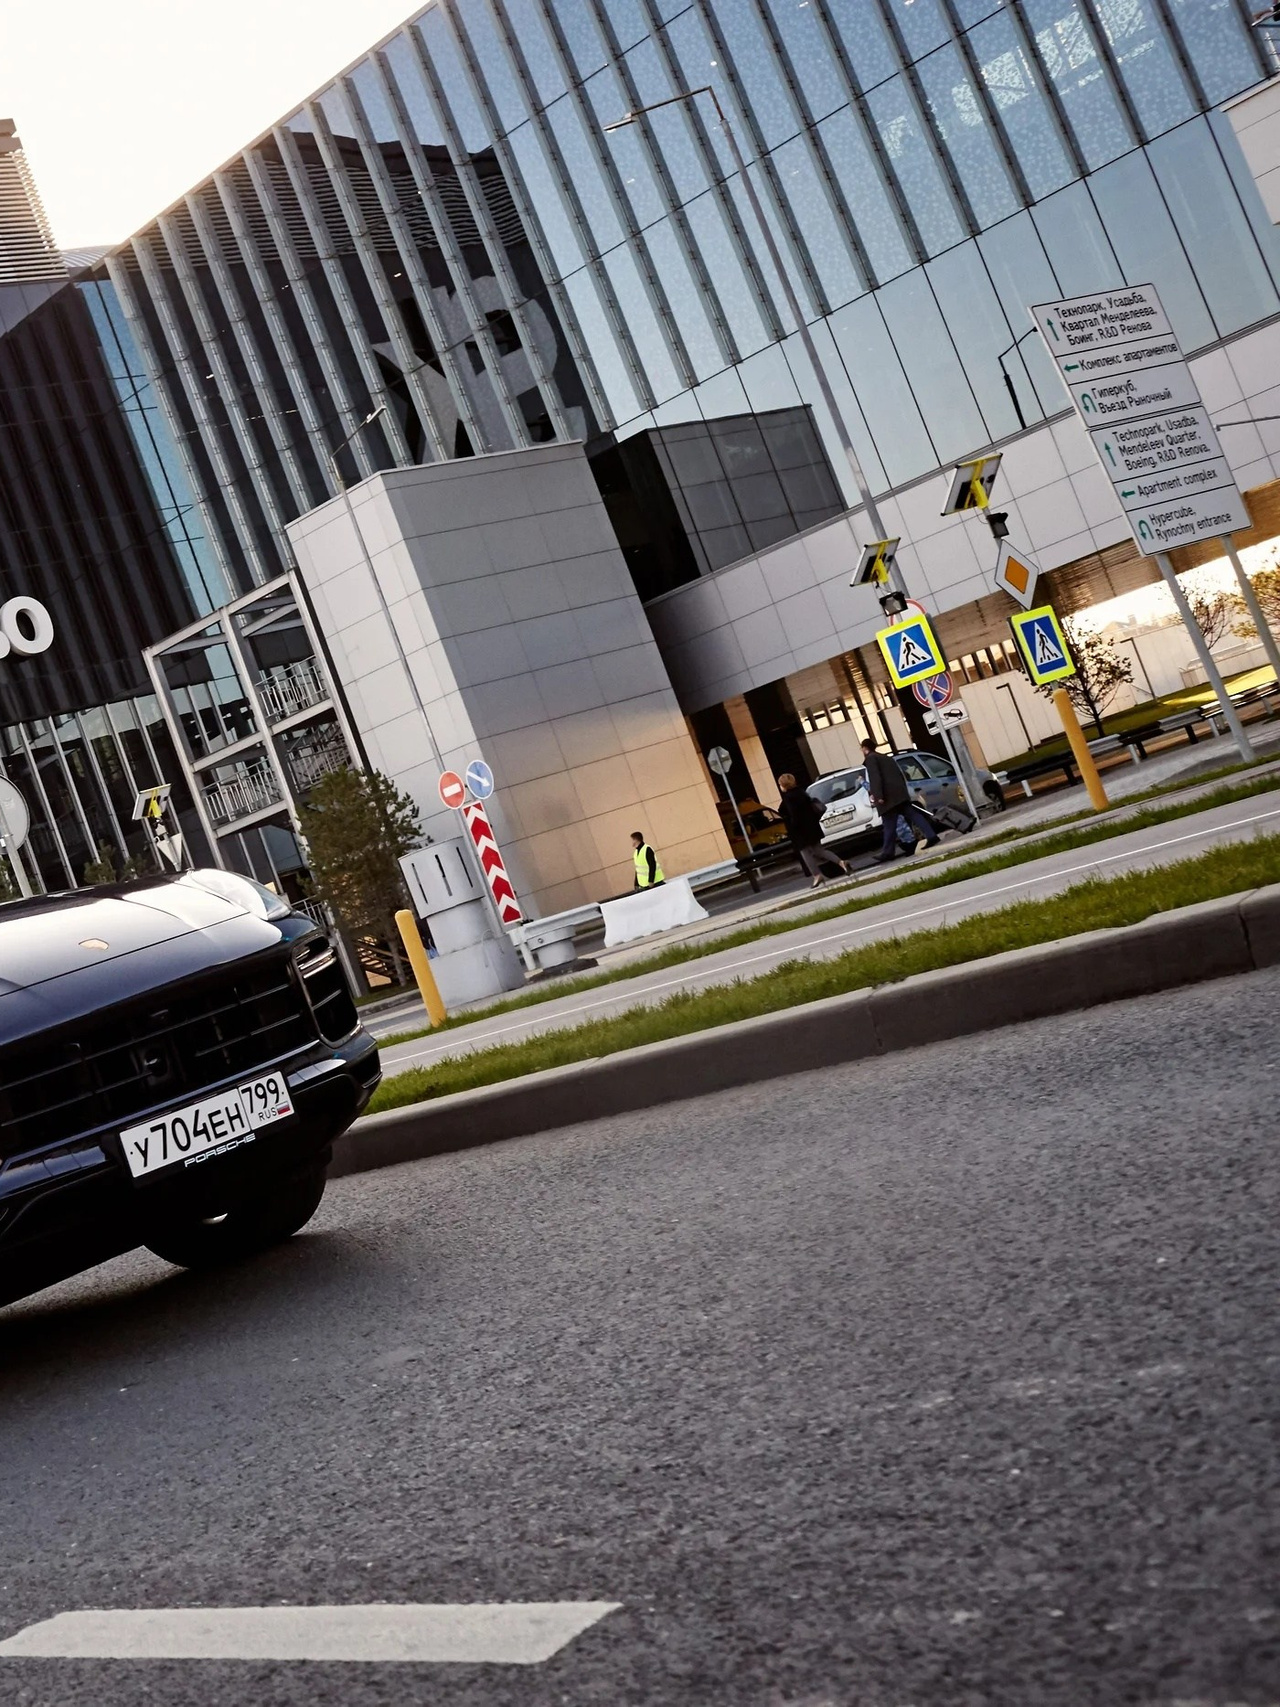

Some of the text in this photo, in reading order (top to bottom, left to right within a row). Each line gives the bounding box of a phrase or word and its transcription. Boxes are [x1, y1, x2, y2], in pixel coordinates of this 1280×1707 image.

[1053, 292, 1148, 319] Технопарк, Усадьба,
[1060, 306, 1158, 333] Квартал Менделеева,
[1066, 321, 1153, 346] Боинг, R&D Ренова
[1078, 343, 1178, 371] Комплекс апартаментов
[1091, 379, 1138, 399] Гиперкуб,
[1098, 388, 1173, 414] Въезд Рыночный
[1111, 415, 1199, 442] Technopark, Usadba,
[1118, 430, 1202, 457] Mendeleev Quarter,
[1124, 457, 1158, 471] Boeing,
[1157, 449, 1177, 462] R&D
[1137, 469, 1219, 498] Apartment complex
[1148, 506, 1197, 528] Hypercube,
[1155, 512, 1233, 542] Rynochny entrance
[240, 1078, 280, 1114] 799
[258, 1108, 278, 1122] RUS
[184, 1132, 257, 1168] PORSCHE
